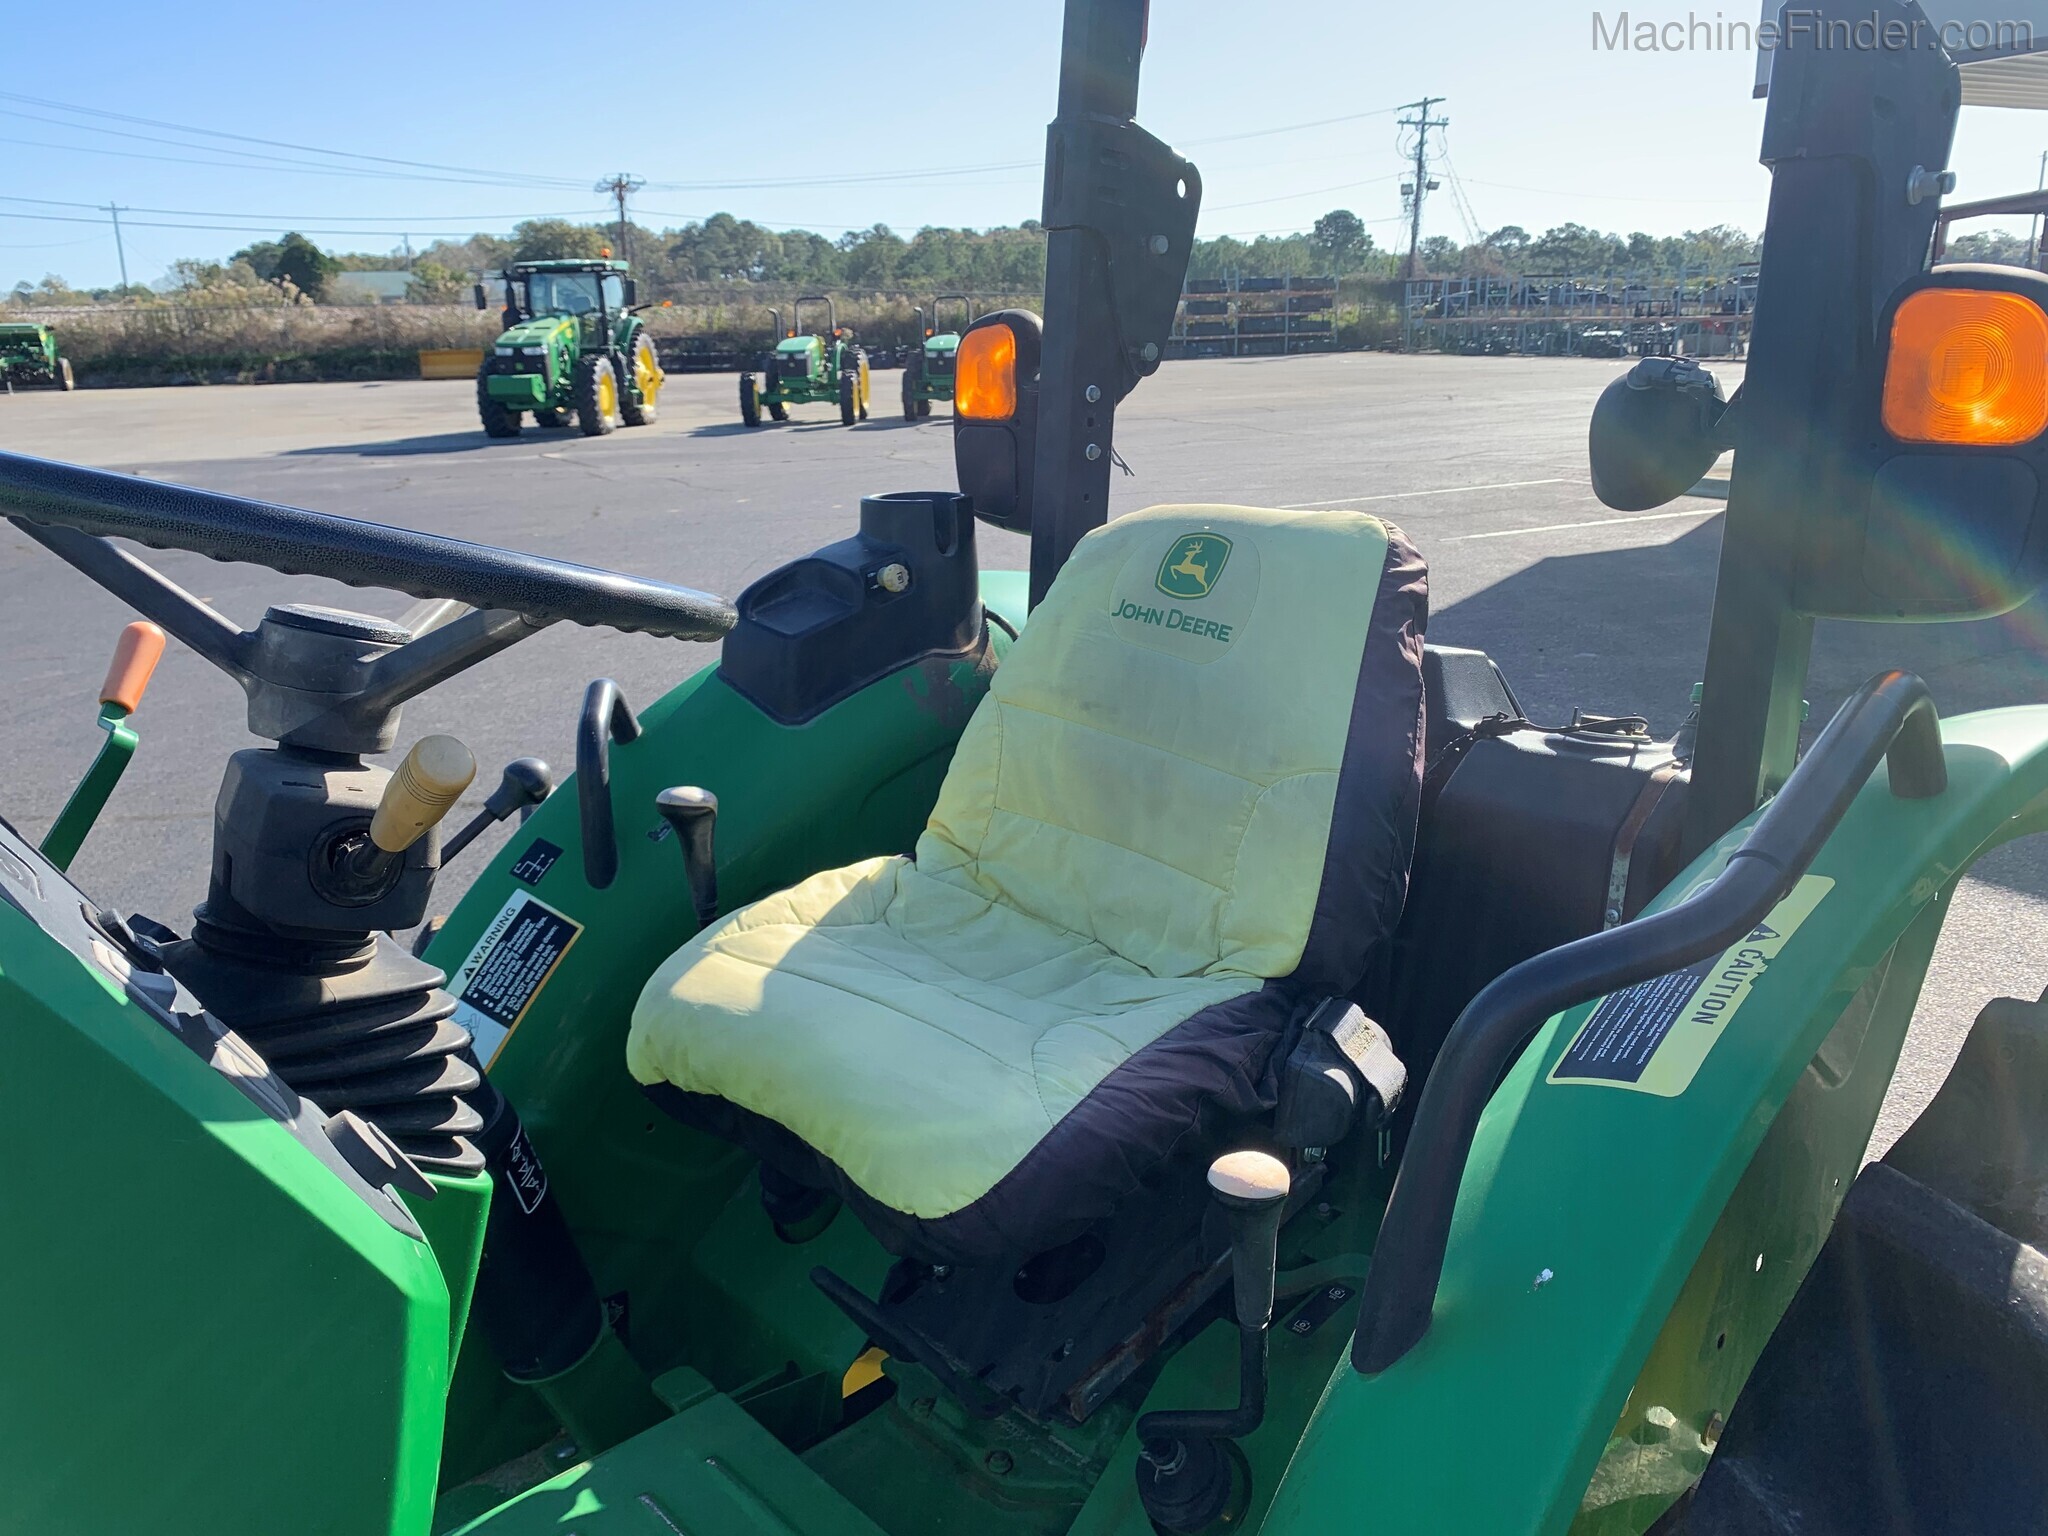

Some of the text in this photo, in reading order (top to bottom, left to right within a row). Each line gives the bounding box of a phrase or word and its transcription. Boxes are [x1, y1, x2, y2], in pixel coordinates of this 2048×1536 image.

[471, 907, 516, 964] WARNING
[478, 972, 492, 990] Keep
[493, 994, 509, 1013] When
[526, 951, 538, 967] must
[502, 959, 516, 975] jump
[465, 975, 482, 995] AVOID
[493, 986, 505, 999] Use
[506, 996, 517, 1007] DO
[514, 982, 526, 996] NOT
[524, 970, 534, 982] use
[513, 993, 527, 1010] Drive
[524, 980, 535, 994] with
[1690, 949, 1763, 1025] CAUTION
